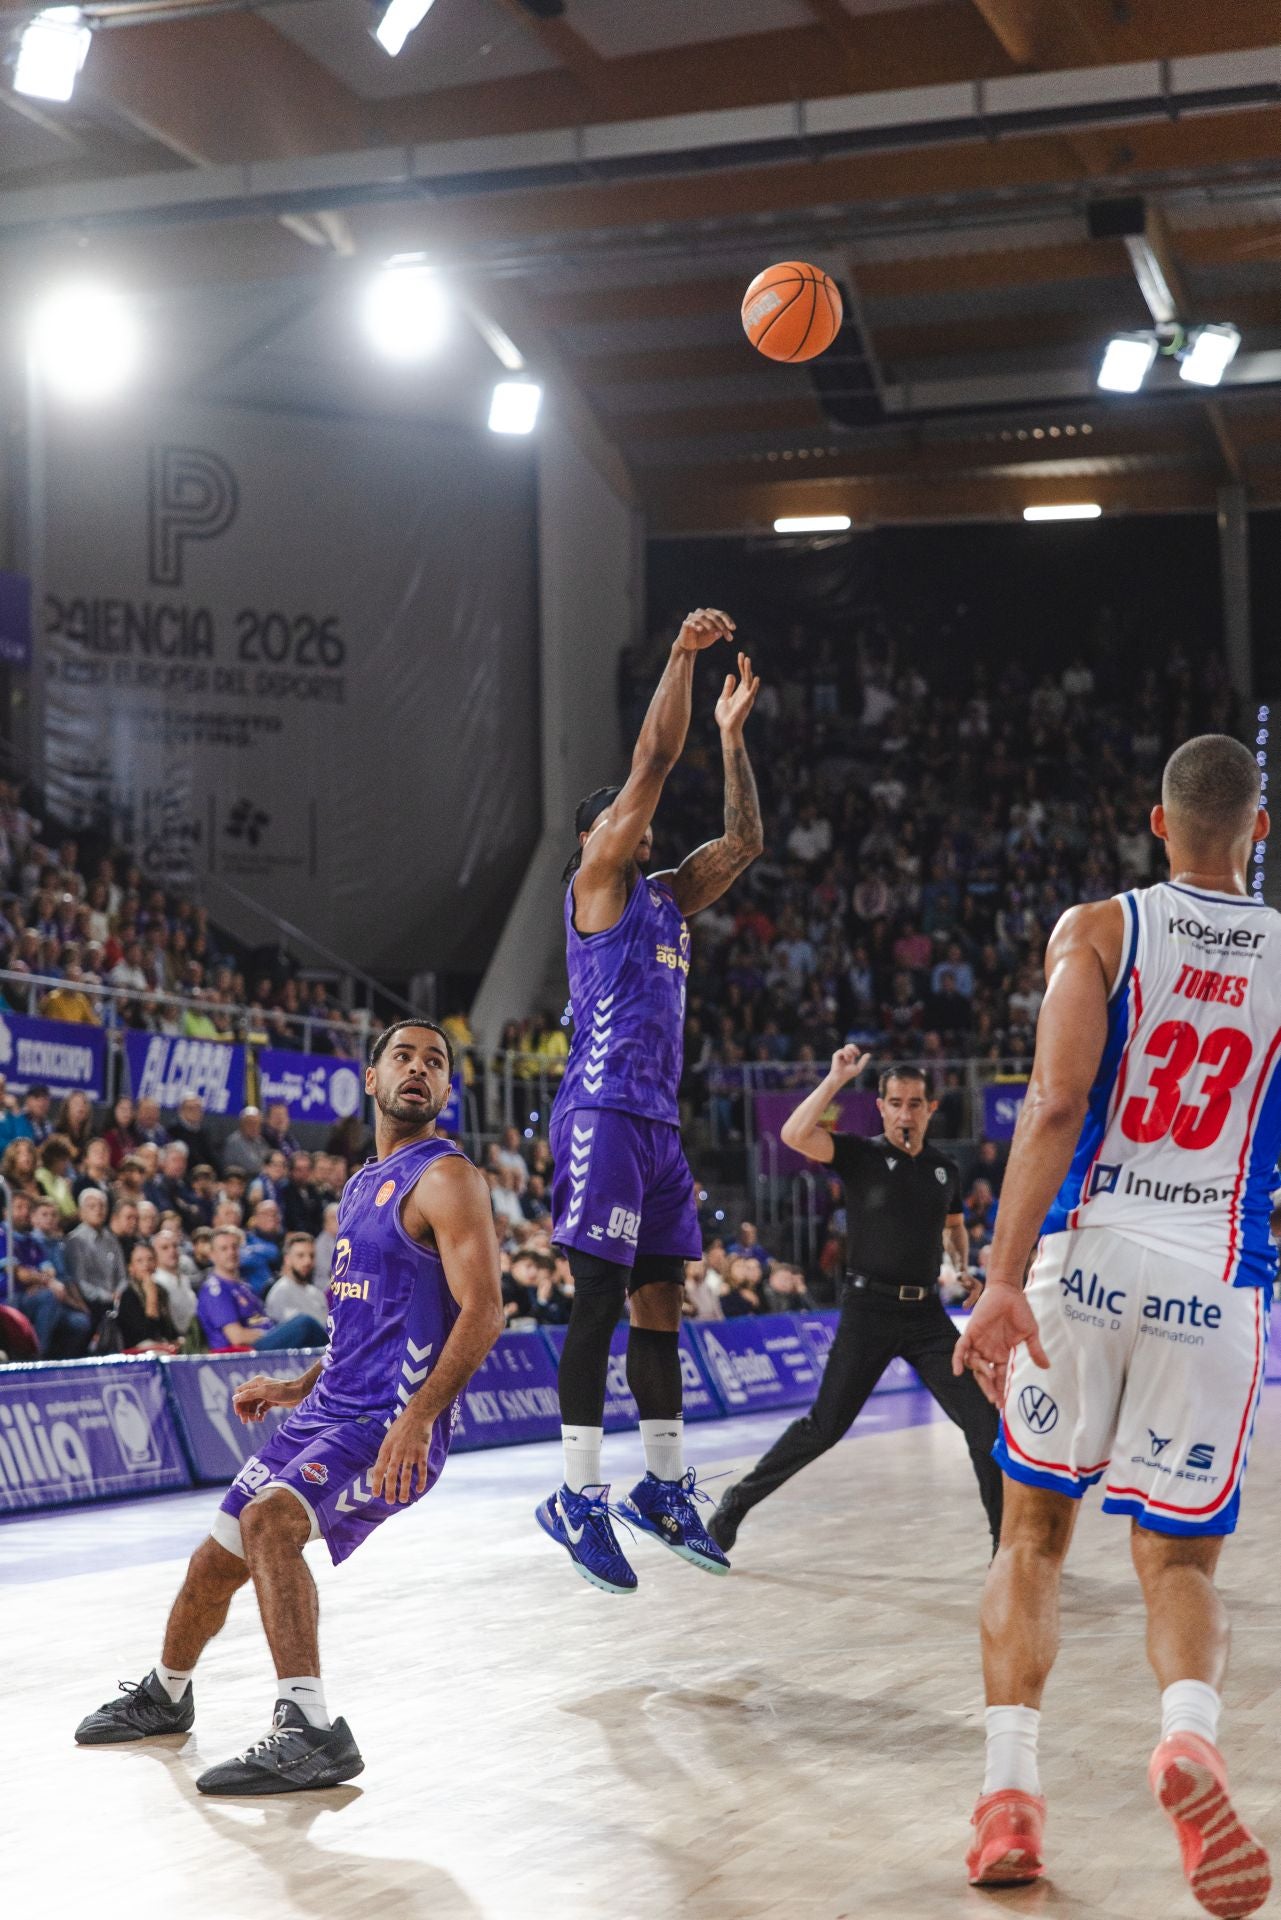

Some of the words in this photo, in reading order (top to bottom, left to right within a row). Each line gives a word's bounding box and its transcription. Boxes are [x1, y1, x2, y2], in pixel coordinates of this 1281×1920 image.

[235, 608, 346, 669] 2026
[1120, 1019, 1253, 1150] 33
[1064, 1303, 1106, 1329] Sports
